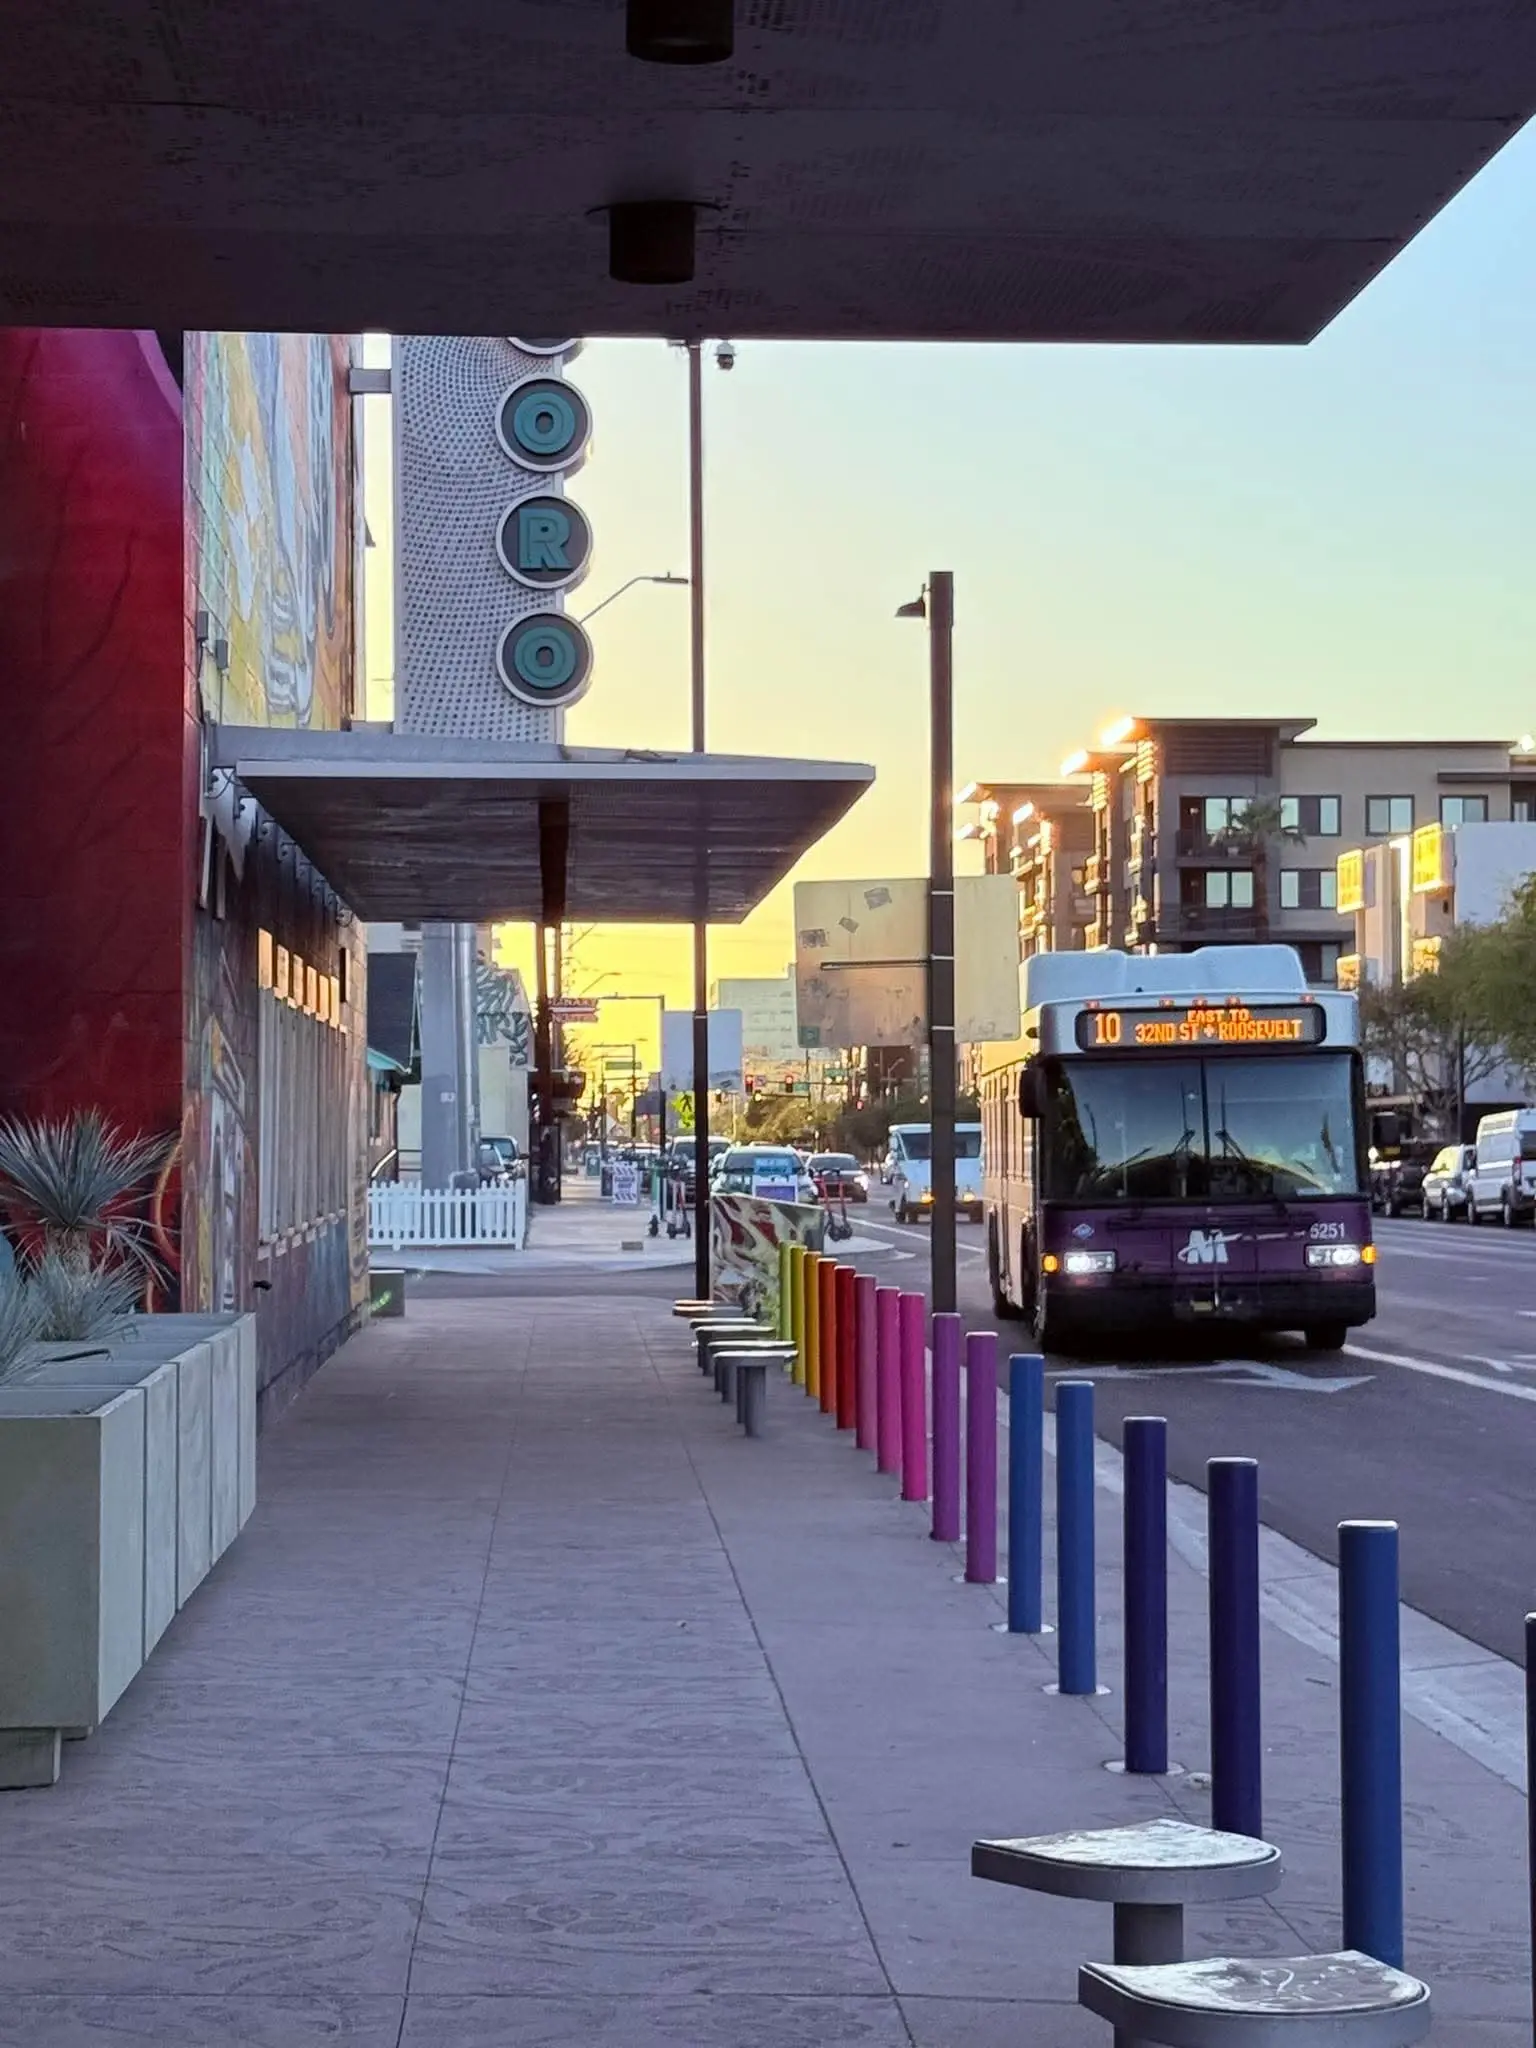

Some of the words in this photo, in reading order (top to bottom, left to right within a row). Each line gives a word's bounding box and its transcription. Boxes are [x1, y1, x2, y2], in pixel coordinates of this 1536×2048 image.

[512, 390, 577, 690] ORO
[1230, 1008, 1250, 1021] TO
[1095, 1012, 1121, 1044] 10
[1135, 1023, 1176, 1043] 32ND
[1179, 1023, 1199, 1041] ST
[1218, 1019, 1302, 1041] ROOSEVELT
[1310, 1222, 1345, 1240] 6251
